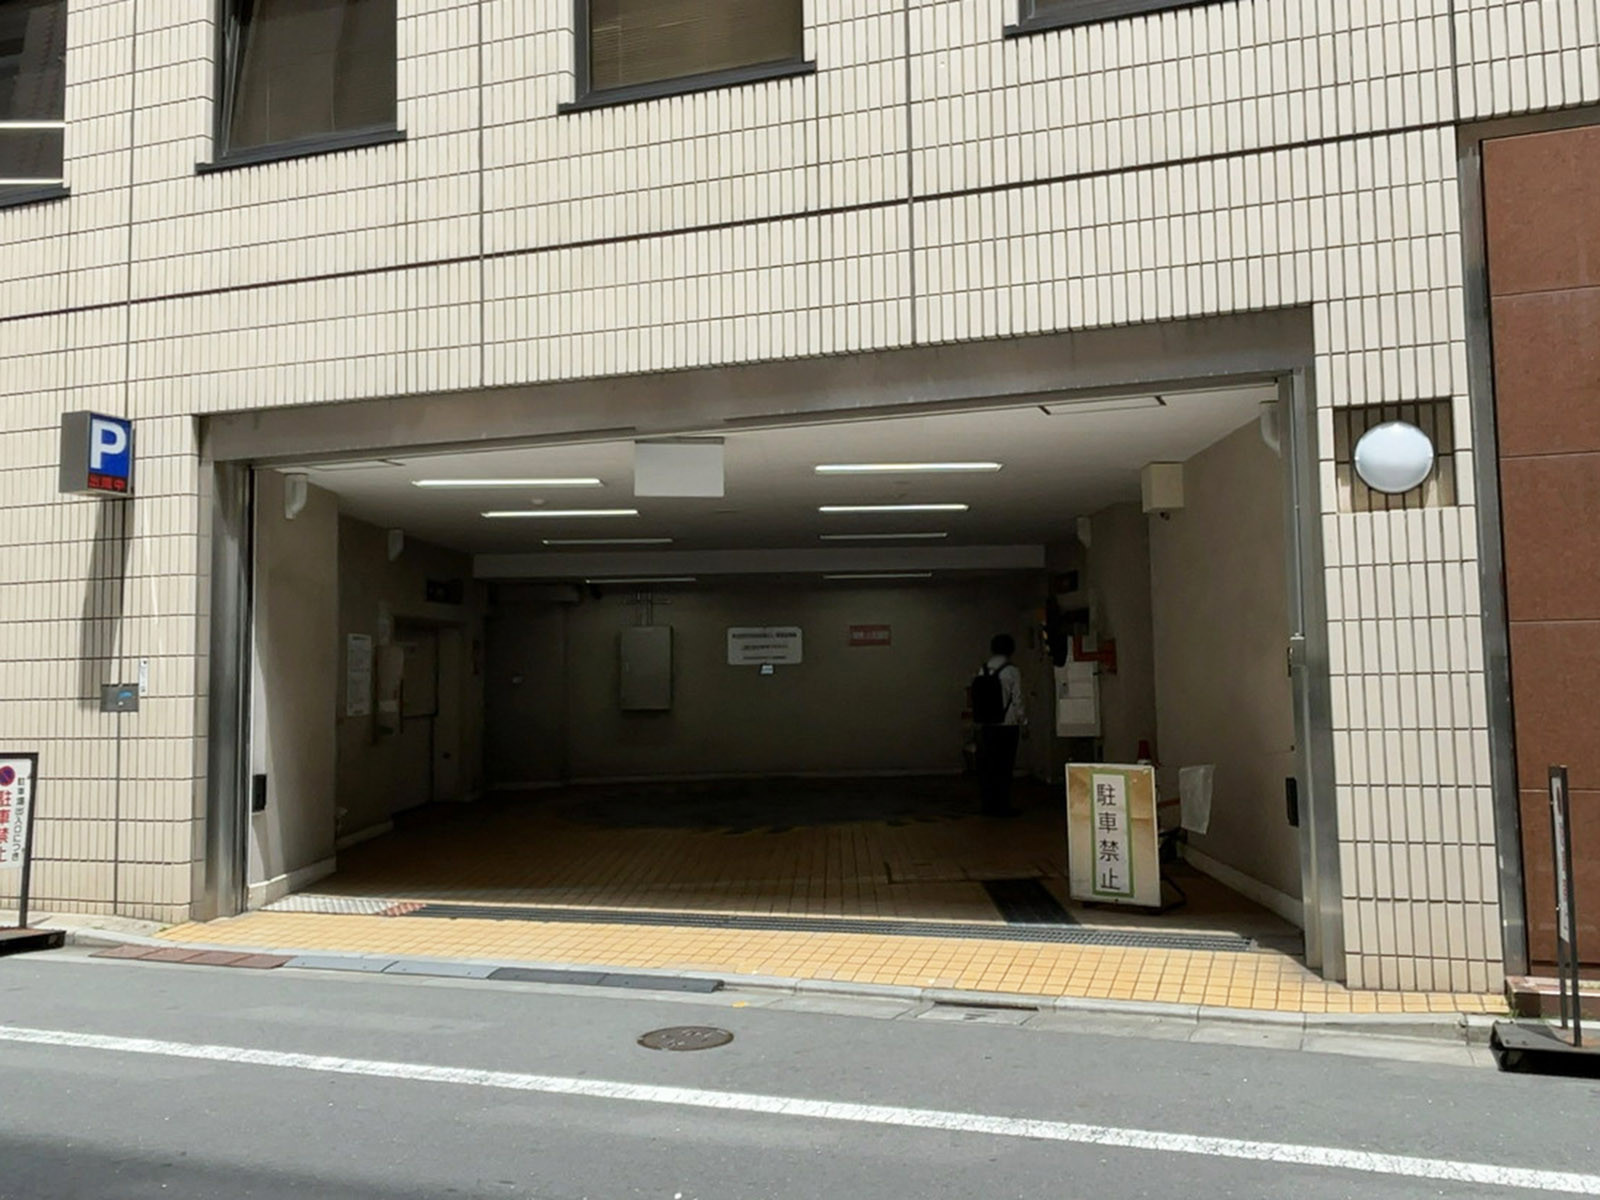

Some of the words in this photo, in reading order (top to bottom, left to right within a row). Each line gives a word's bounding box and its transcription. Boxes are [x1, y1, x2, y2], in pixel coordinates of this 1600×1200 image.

[91, 419, 126, 469] P
[1096, 783, 1121, 890] 駐車禁止
